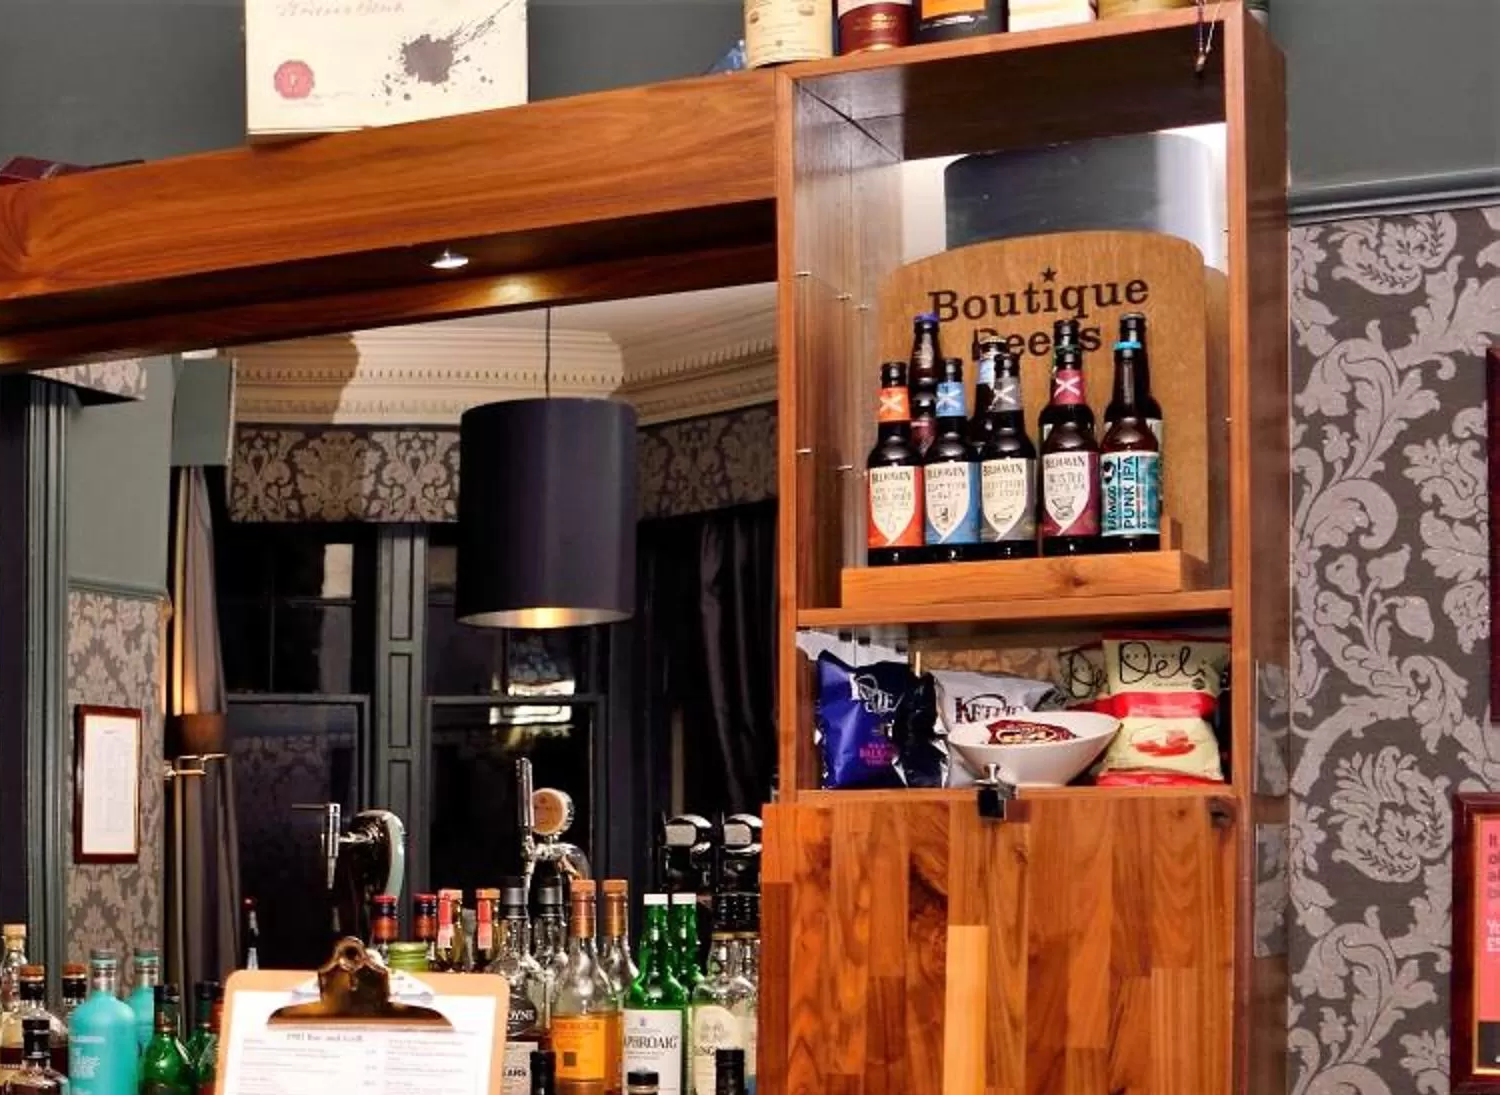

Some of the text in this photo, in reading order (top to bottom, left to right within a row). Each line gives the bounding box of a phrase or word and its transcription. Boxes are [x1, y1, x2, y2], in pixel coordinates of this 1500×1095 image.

[928, 270, 1150, 323] Boutique
[971, 325, 1102, 361] Bees
[1123, 456, 1135, 530] PUNK IPA
